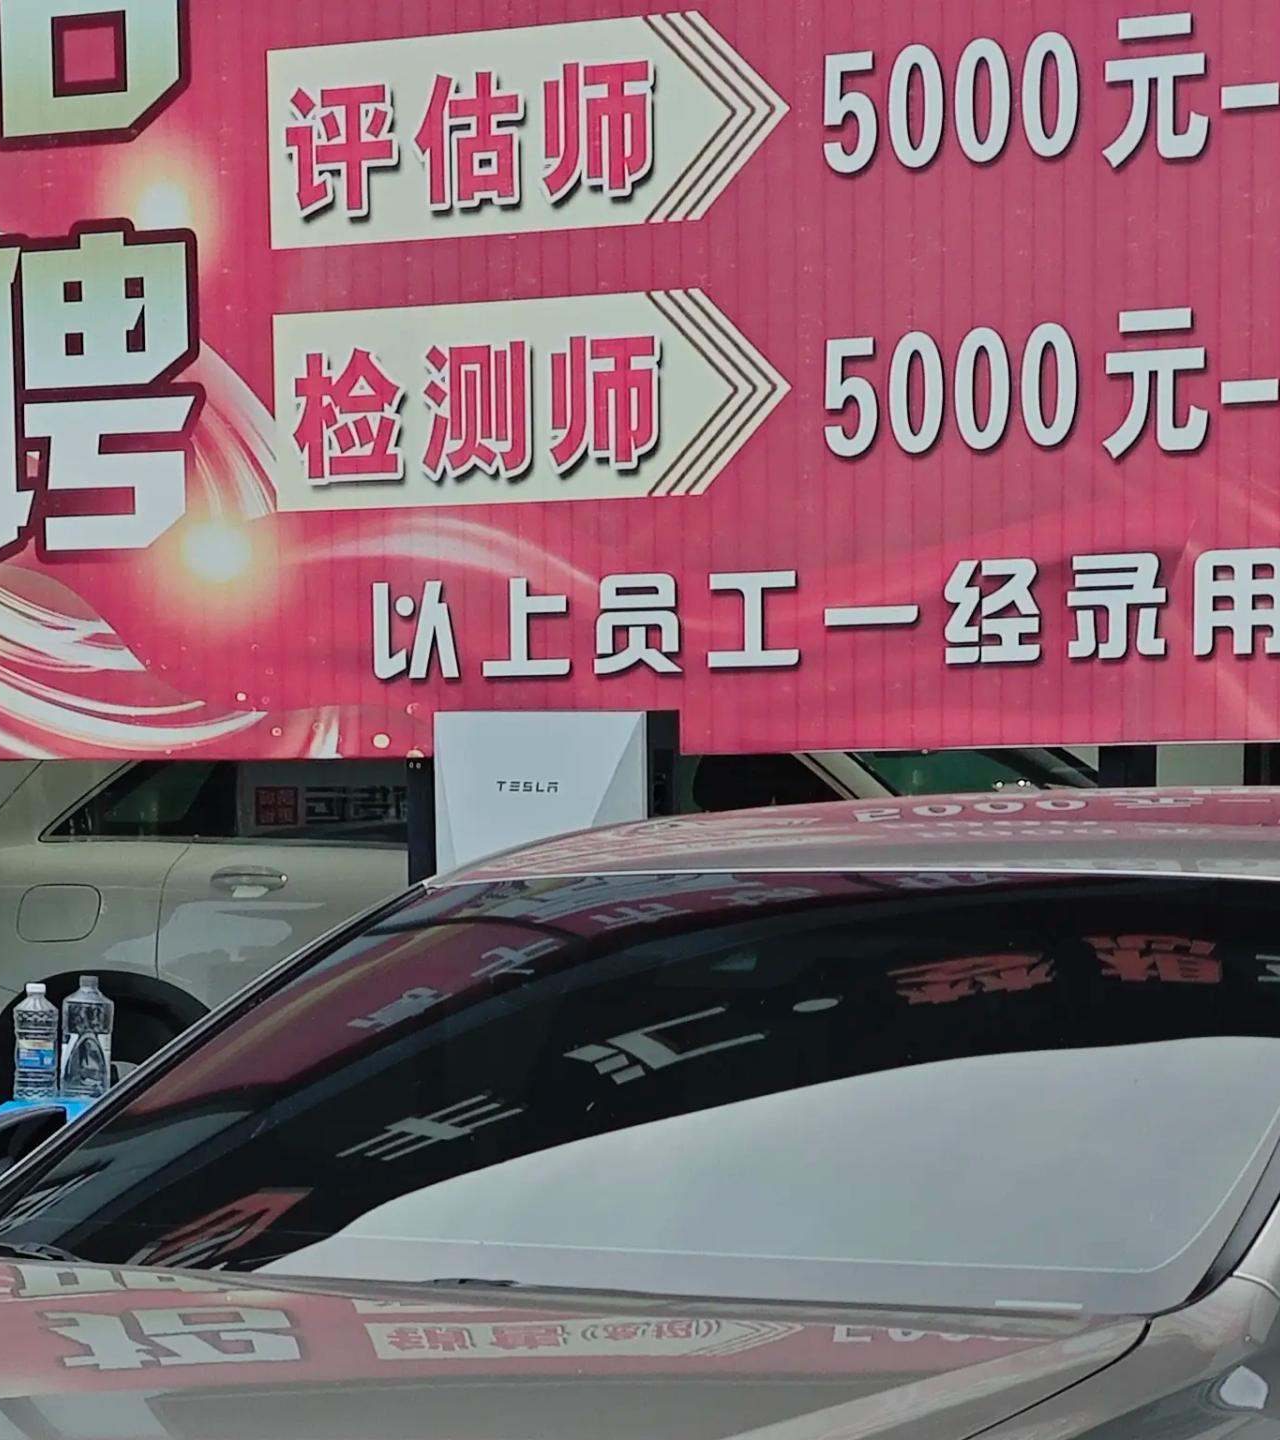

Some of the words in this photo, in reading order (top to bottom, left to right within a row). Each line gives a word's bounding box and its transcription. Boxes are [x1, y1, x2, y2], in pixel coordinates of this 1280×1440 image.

[285, 58, 658, 222] 评估师
[293, 334, 663, 485] 检测师
[496, 780, 559, 794] TESLA
